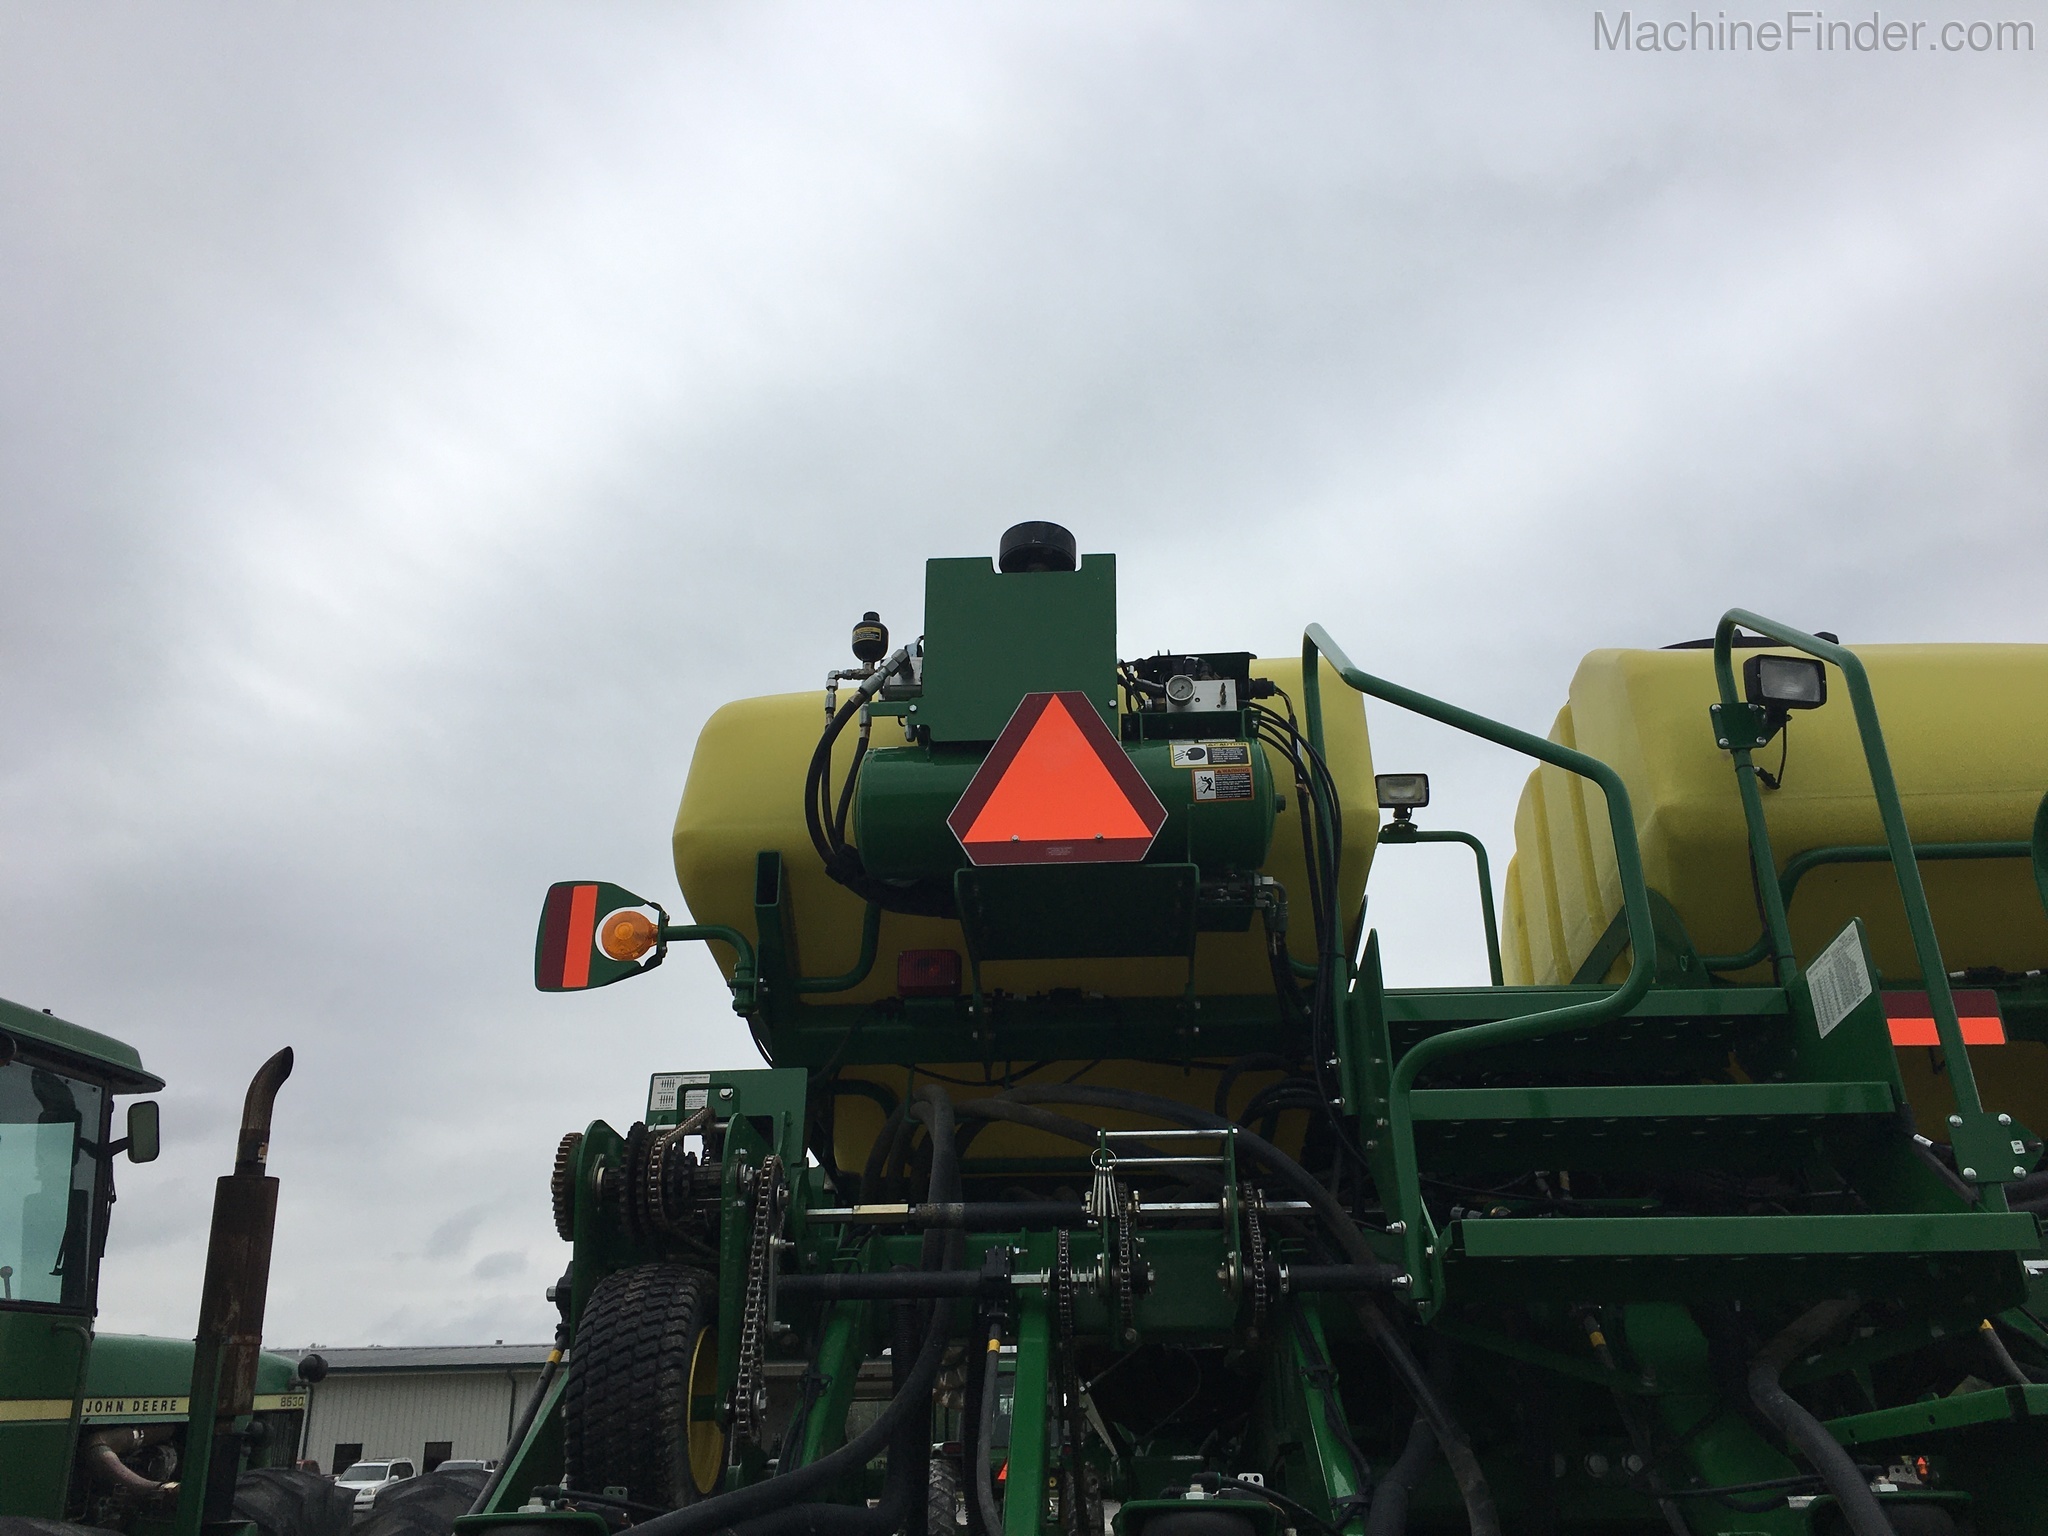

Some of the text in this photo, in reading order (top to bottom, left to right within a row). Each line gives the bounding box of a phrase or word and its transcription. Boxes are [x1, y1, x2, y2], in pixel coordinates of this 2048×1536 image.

[85, 1399, 178, 1414] JOHN DEERE
[280, 1396, 304, 1407] 8630
